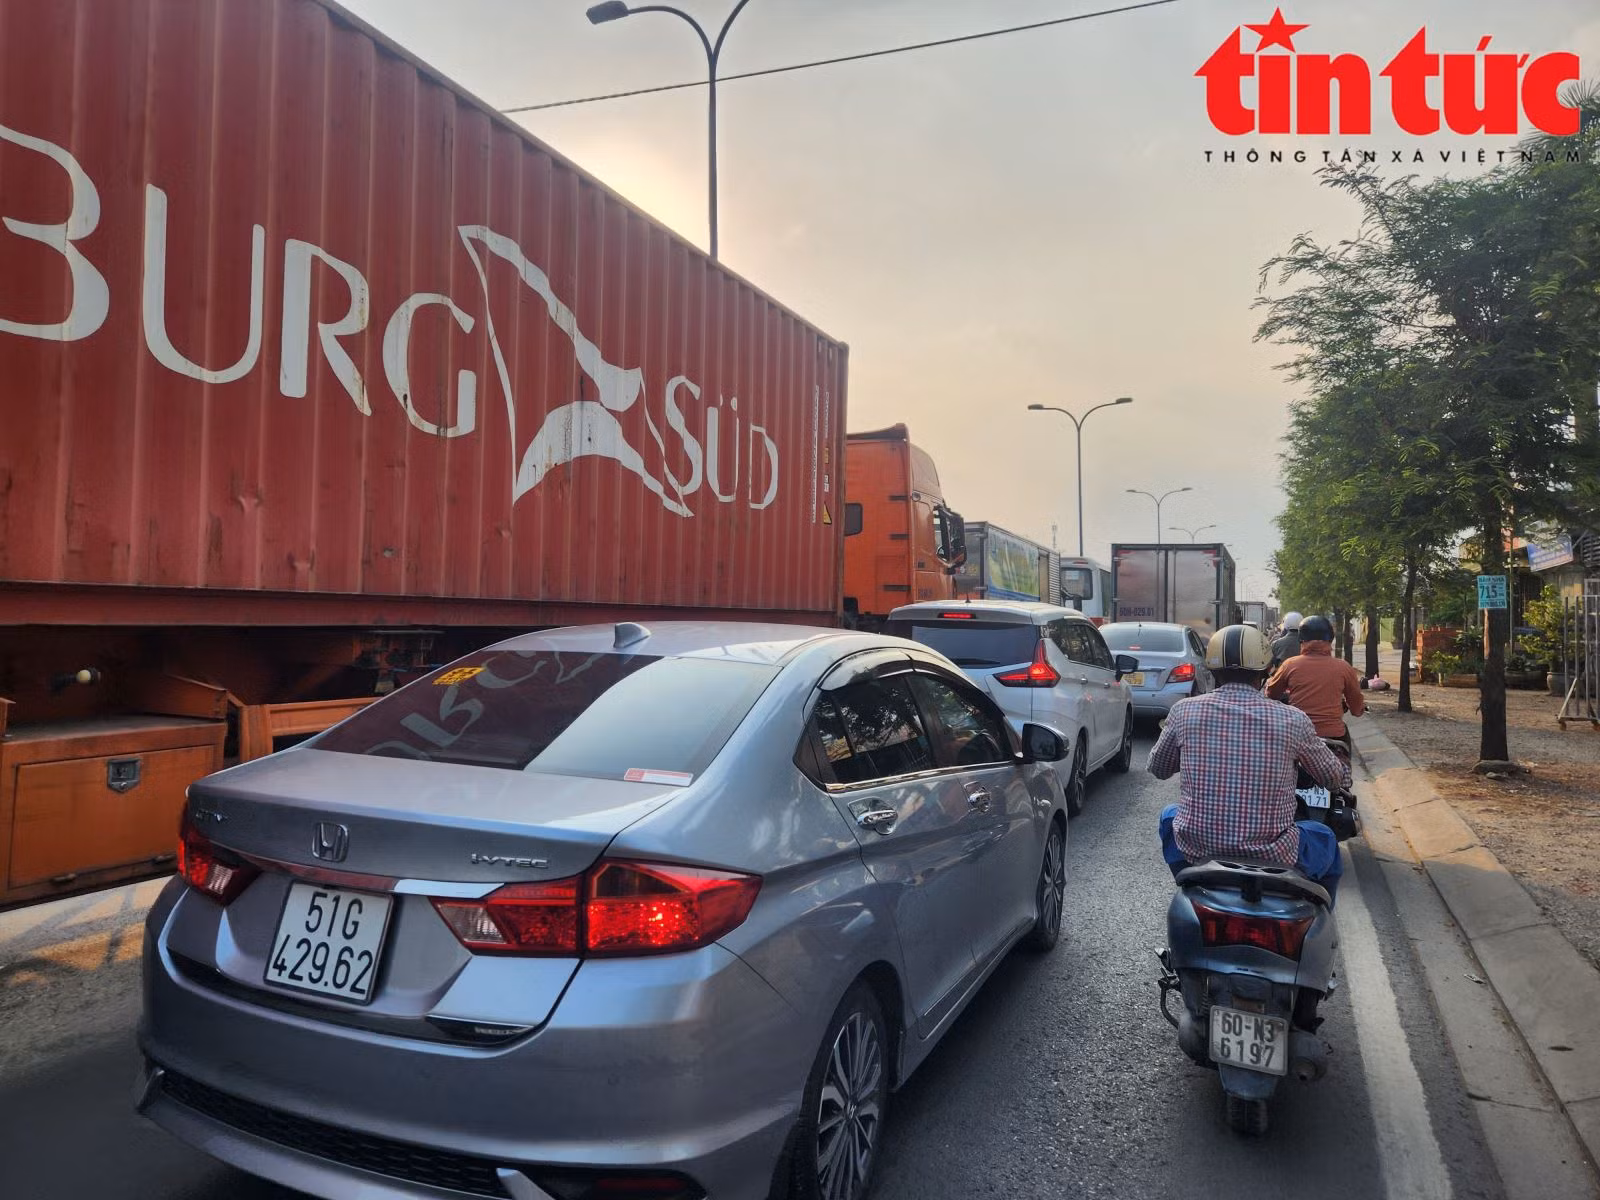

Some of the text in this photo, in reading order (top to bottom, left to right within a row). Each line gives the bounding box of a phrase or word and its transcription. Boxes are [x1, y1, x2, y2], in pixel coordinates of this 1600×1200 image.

[665, 374, 779, 510] SÜD
[305, 891, 363, 940] 51G
[272, 934, 374, 995] 429.62
[1221, 1012, 1275, 1042] 60-N3
[1220, 1037, 1276, 1068] 6197
